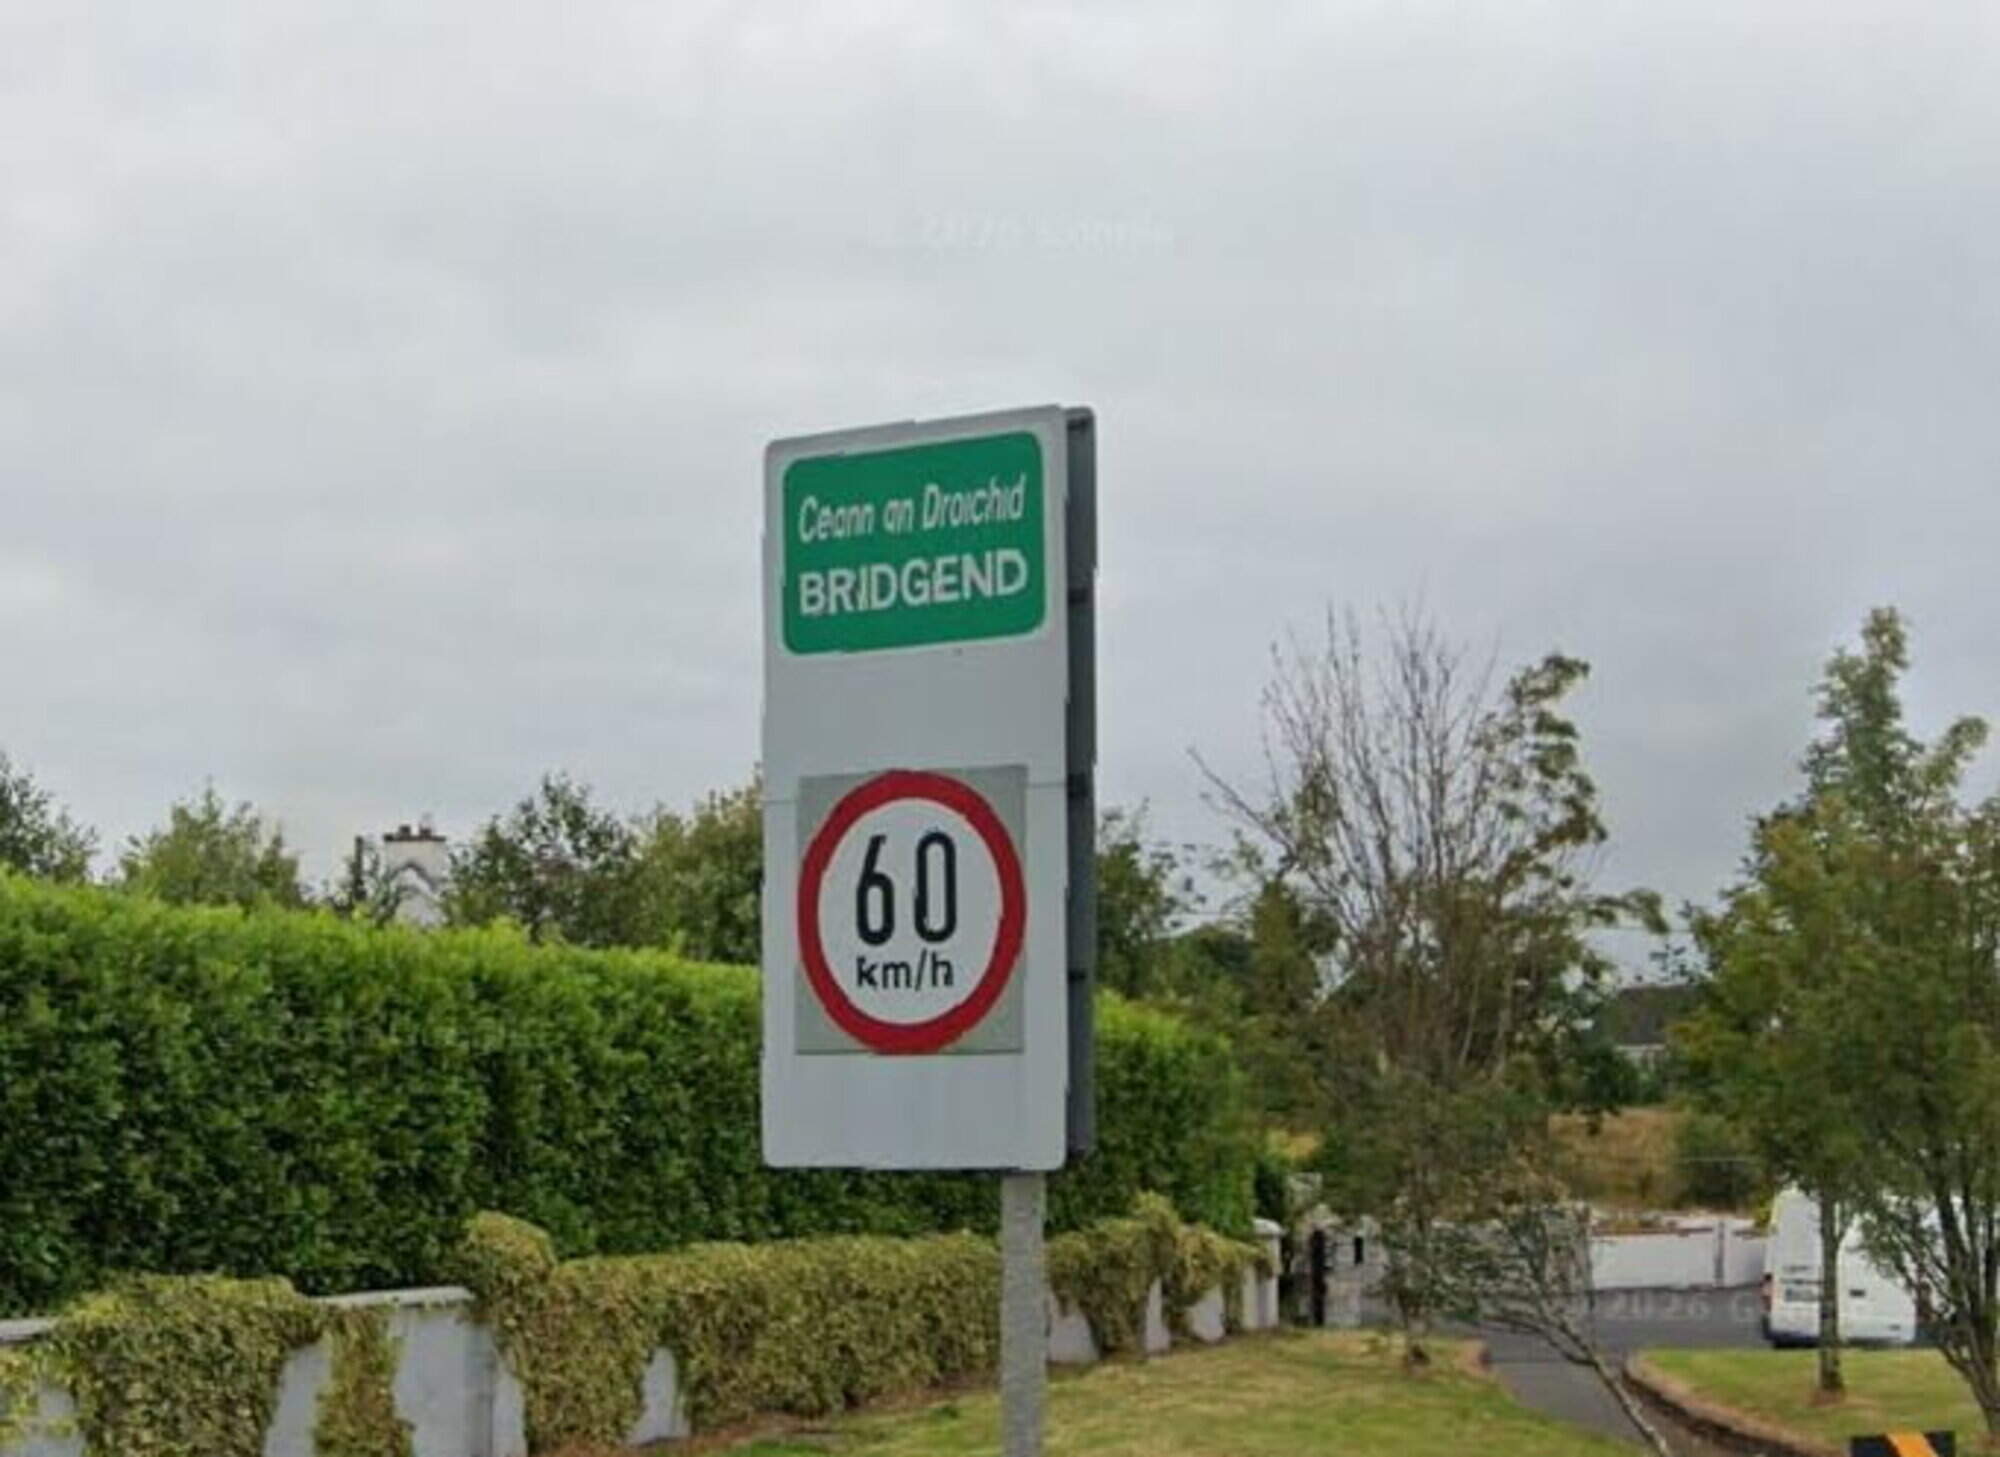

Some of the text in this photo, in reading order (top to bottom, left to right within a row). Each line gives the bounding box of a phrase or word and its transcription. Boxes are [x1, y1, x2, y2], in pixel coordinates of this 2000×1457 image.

[798, 472, 1027, 543] Ceann an Droichid
[799, 549, 1029, 617] BRIDGEND
[856, 831, 957, 946] 60
[856, 948, 954, 991] km/h
